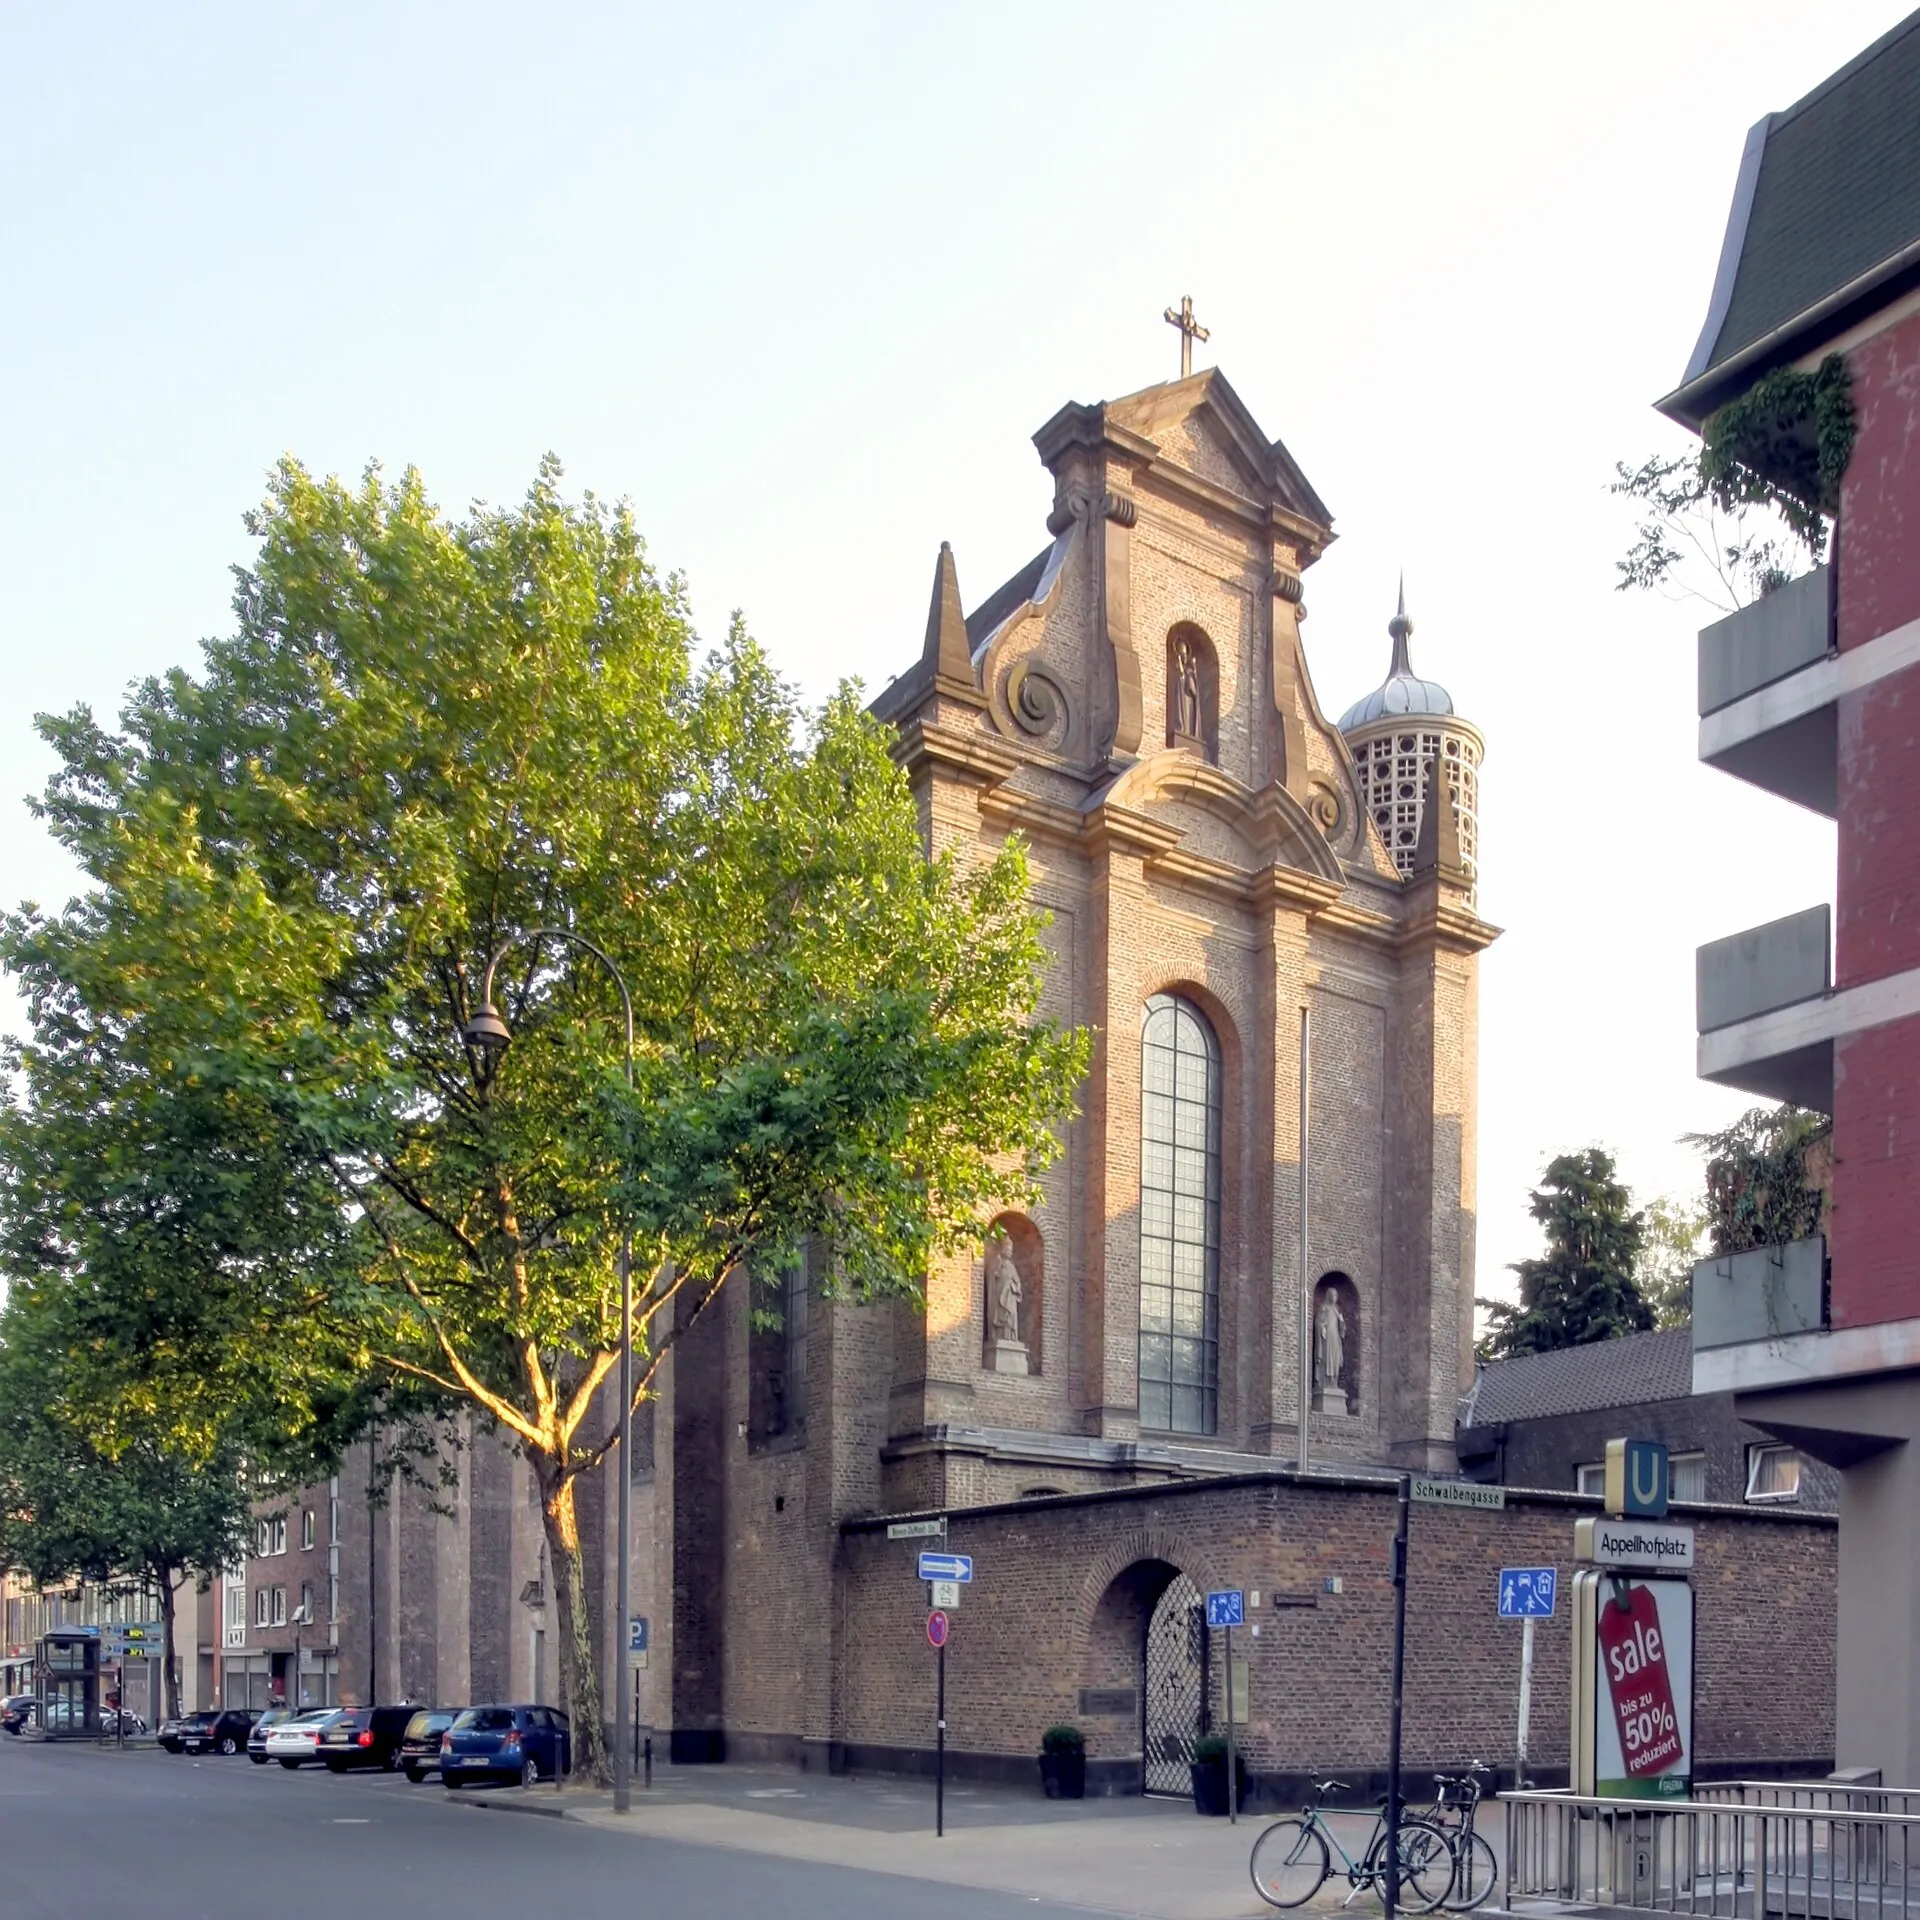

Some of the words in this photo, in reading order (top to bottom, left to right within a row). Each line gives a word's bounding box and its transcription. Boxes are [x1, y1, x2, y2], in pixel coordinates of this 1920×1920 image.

[1632, 1450, 1658, 1505] U
[1415, 1481, 1500, 1506] Schwalbengasse
[1601, 1533, 1687, 1558] Appellhofplatz
[629, 1621, 642, 1647] P
[1610, 1620, 1661, 1682] sale
[1620, 1699, 1638, 1717] bis
[1639, 1692, 1653, 1708] zu
[1625, 1702, 1674, 1751] 50%
[1629, 1735, 1678, 1772] reduziert
